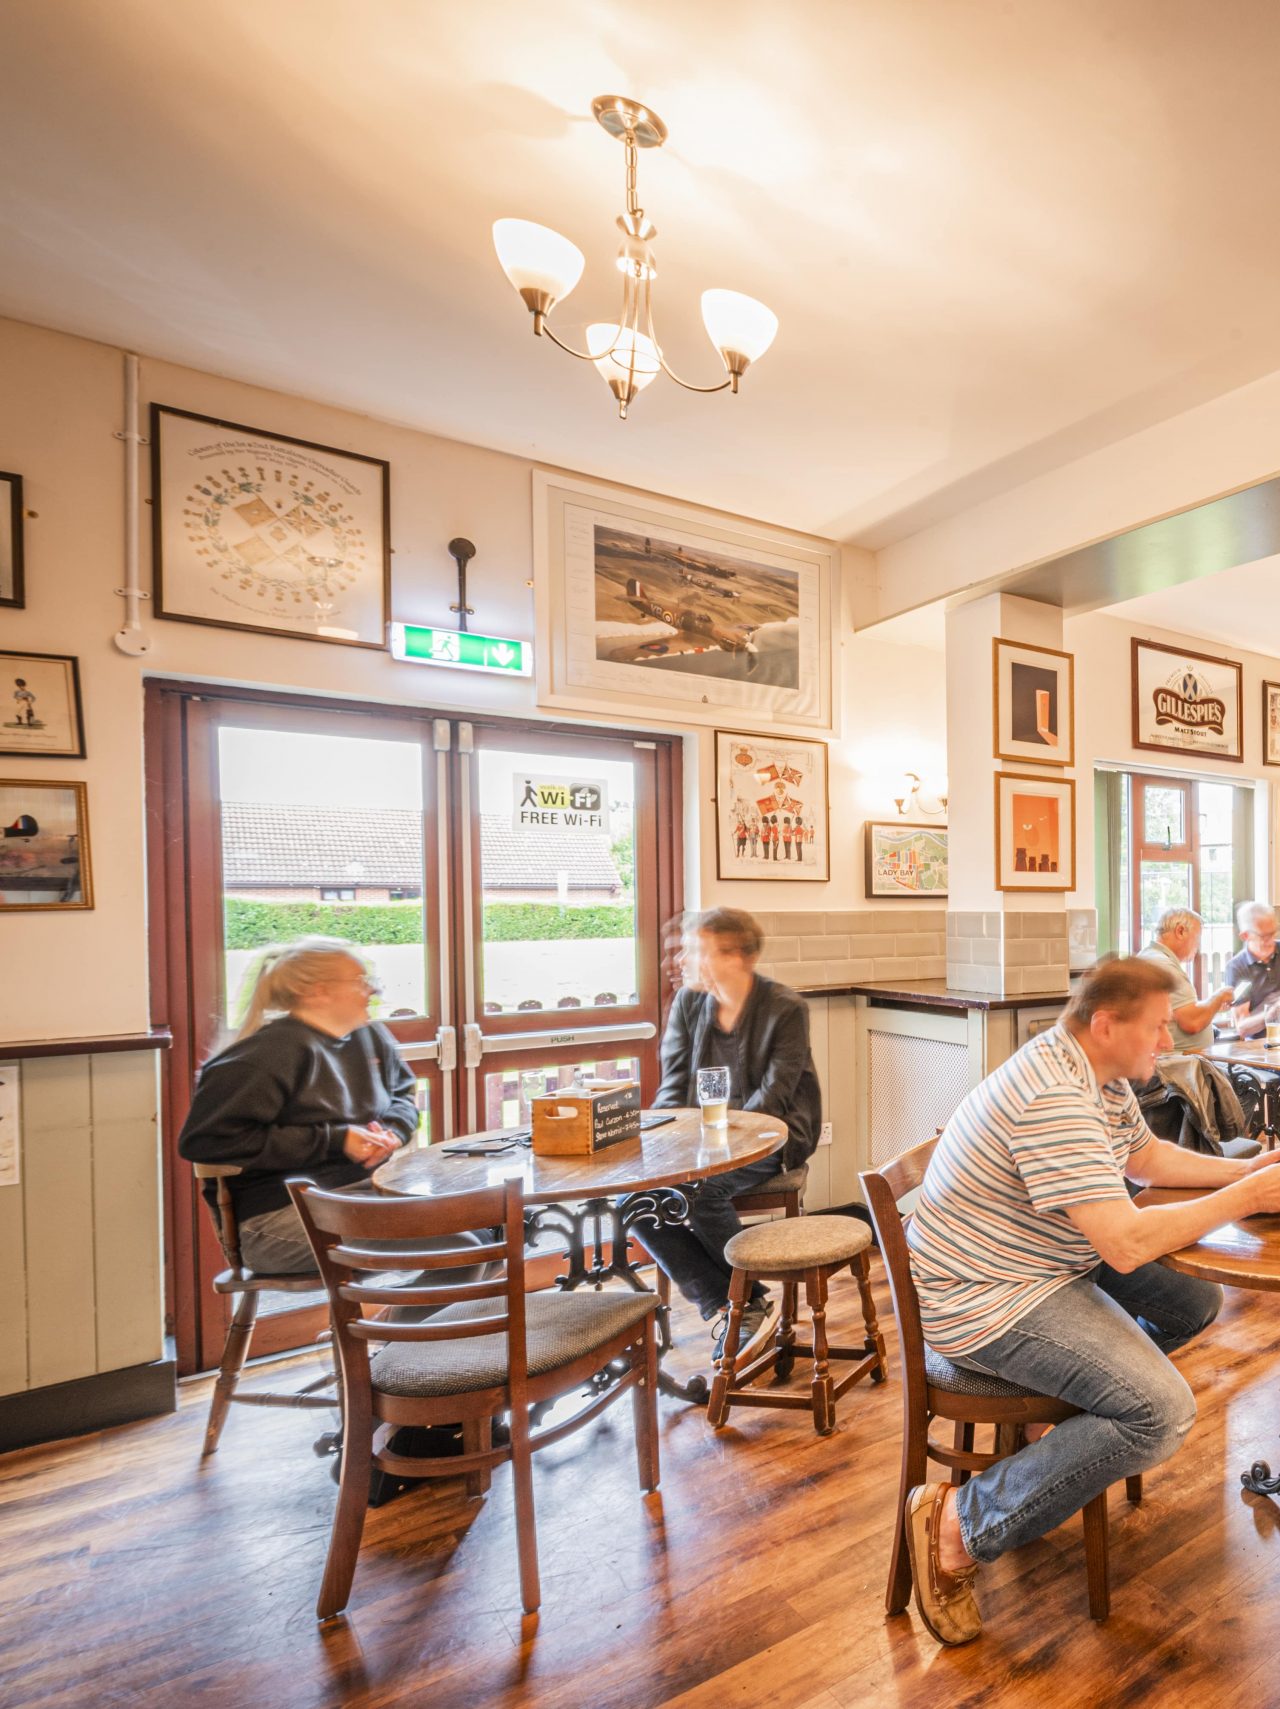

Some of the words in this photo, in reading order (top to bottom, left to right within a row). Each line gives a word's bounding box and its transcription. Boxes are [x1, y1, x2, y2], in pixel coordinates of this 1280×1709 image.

[1158, 693, 1222, 722] GILLESPIE'S
[520, 812, 558, 824] FREE
[564, 814, 602, 827] Wi-Fi
[550, 1036, 574, 1044] PUSH
[597, 1100, 620, 1114] Reserved
